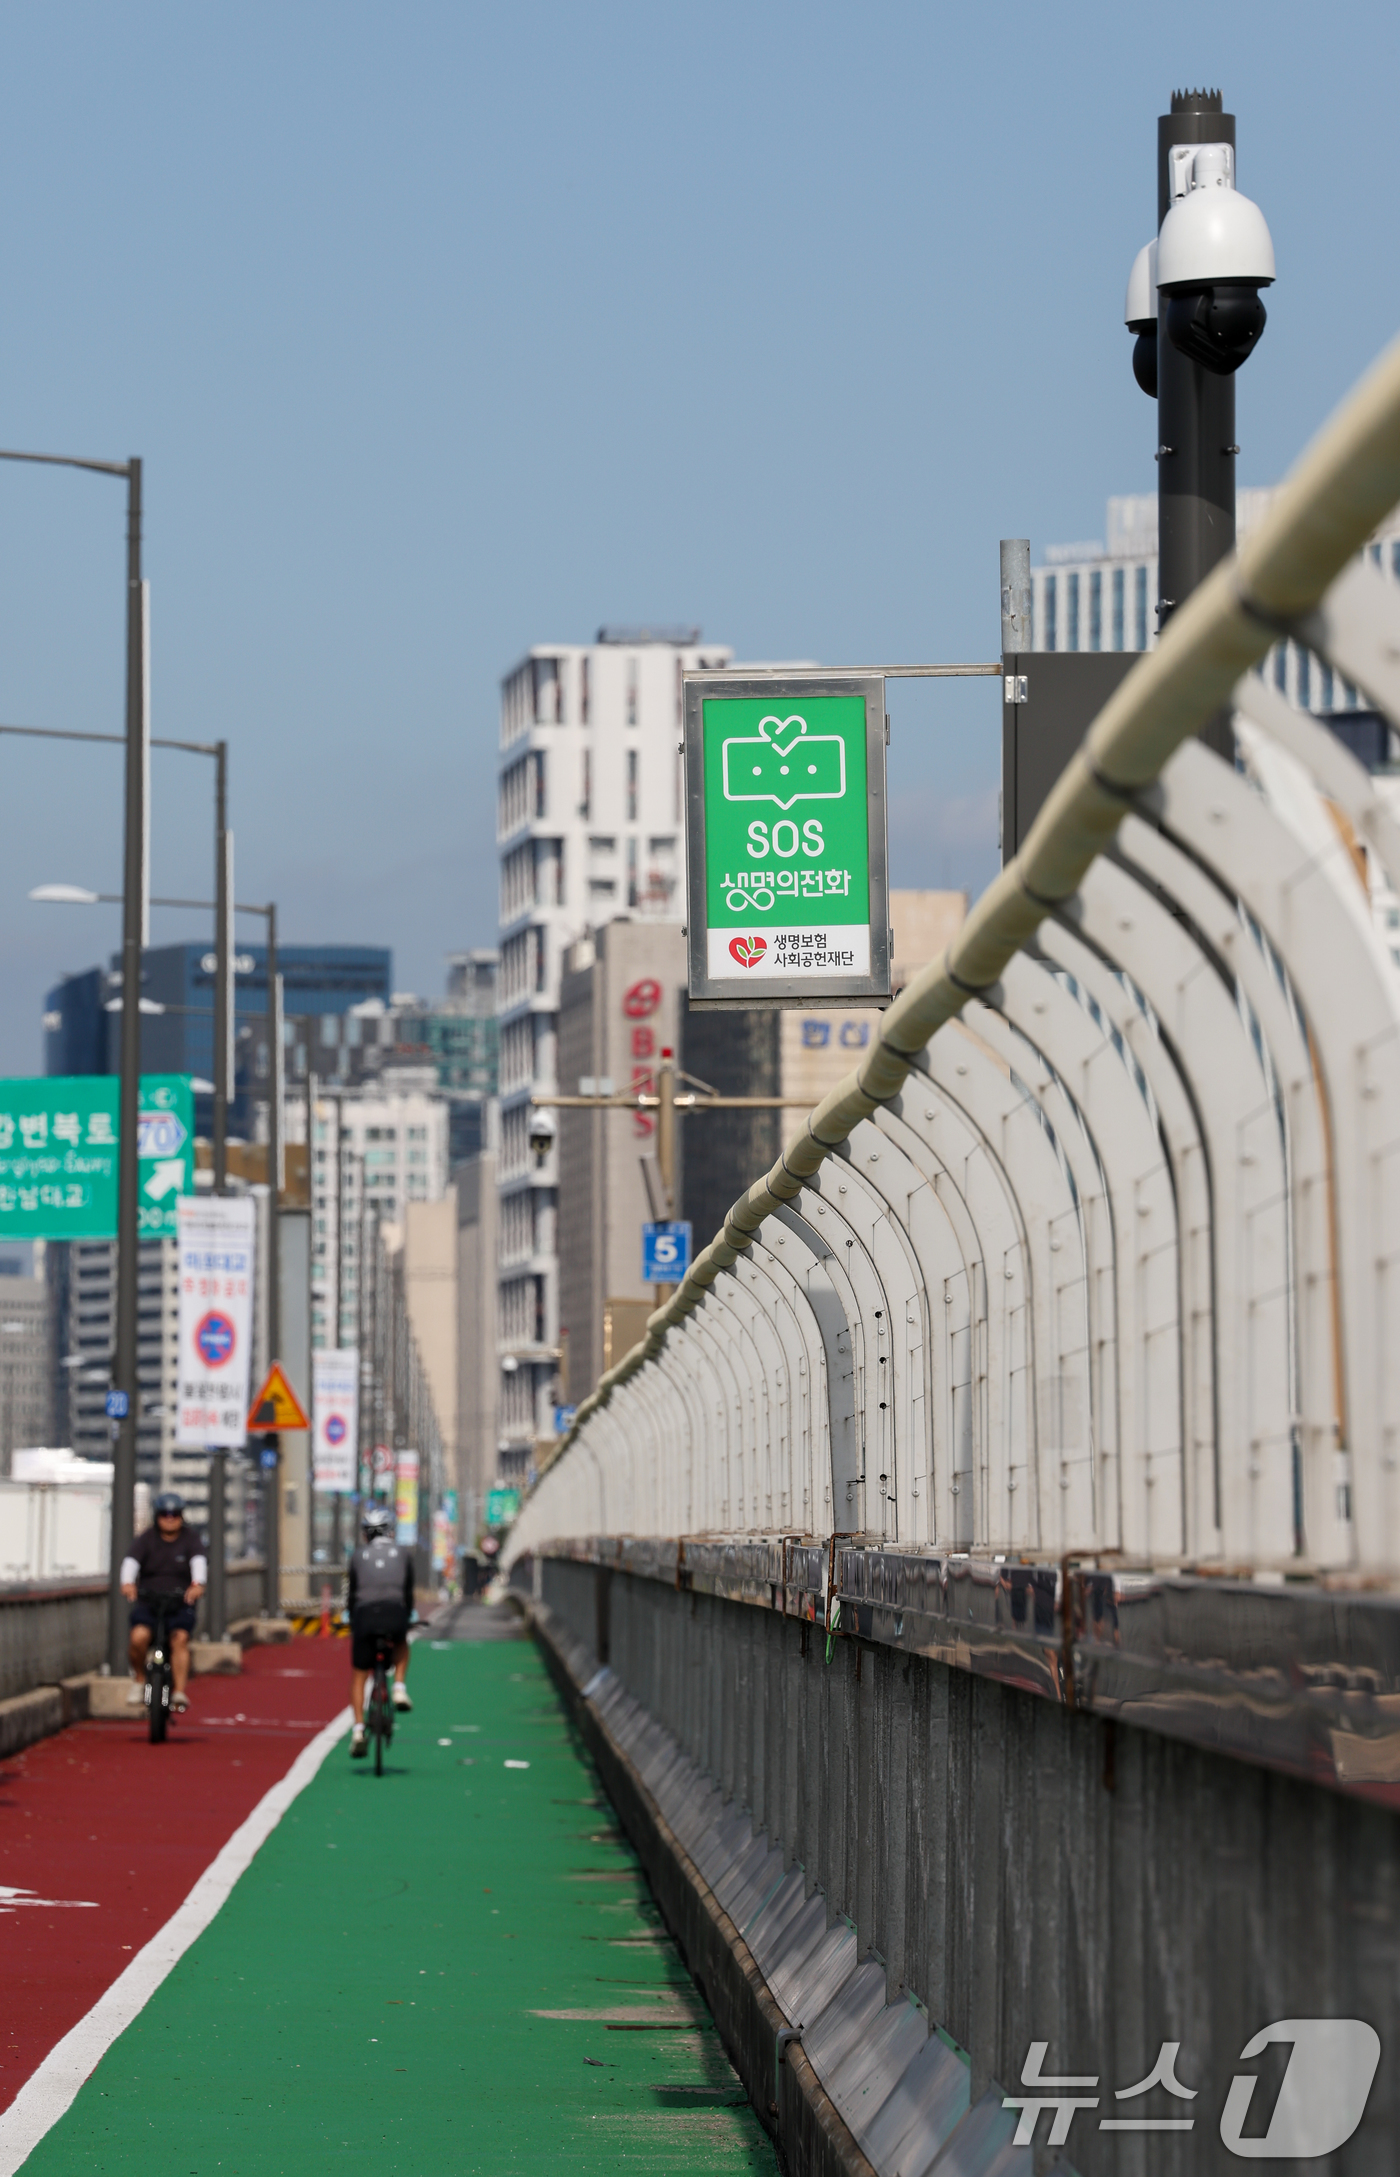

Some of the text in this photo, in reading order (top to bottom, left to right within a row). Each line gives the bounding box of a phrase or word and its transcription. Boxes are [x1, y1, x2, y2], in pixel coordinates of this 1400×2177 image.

[747, 819, 825, 859] SOS
[720, 868, 852, 912] 생명의전화
[773, 933, 828, 950] 생명보험
[773, 951, 855, 968] 사회공헌재단
[654, 1235, 678, 1263] 5
